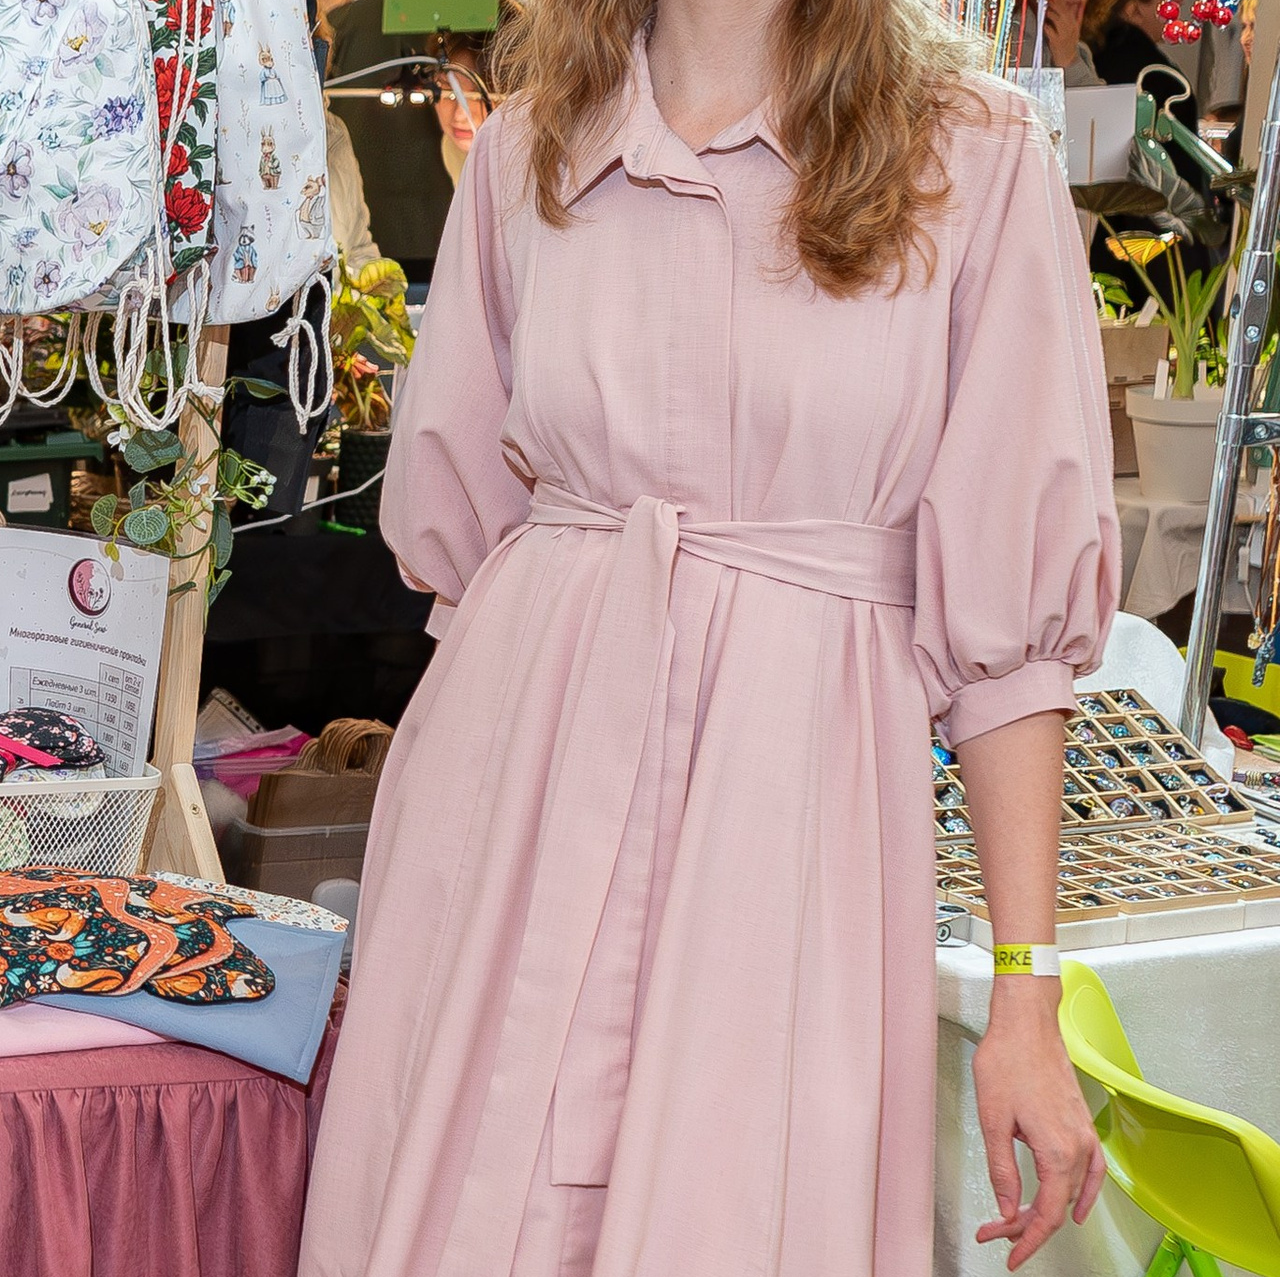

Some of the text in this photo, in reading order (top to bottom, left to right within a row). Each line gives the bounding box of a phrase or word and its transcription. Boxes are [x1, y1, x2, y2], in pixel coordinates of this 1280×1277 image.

[69, 615, 95, 630] General
[9, 627, 69, 644] Многоразовые
[70, 638, 120, 657] гигиенические
[32, 676, 79, 692] Ежедневные
